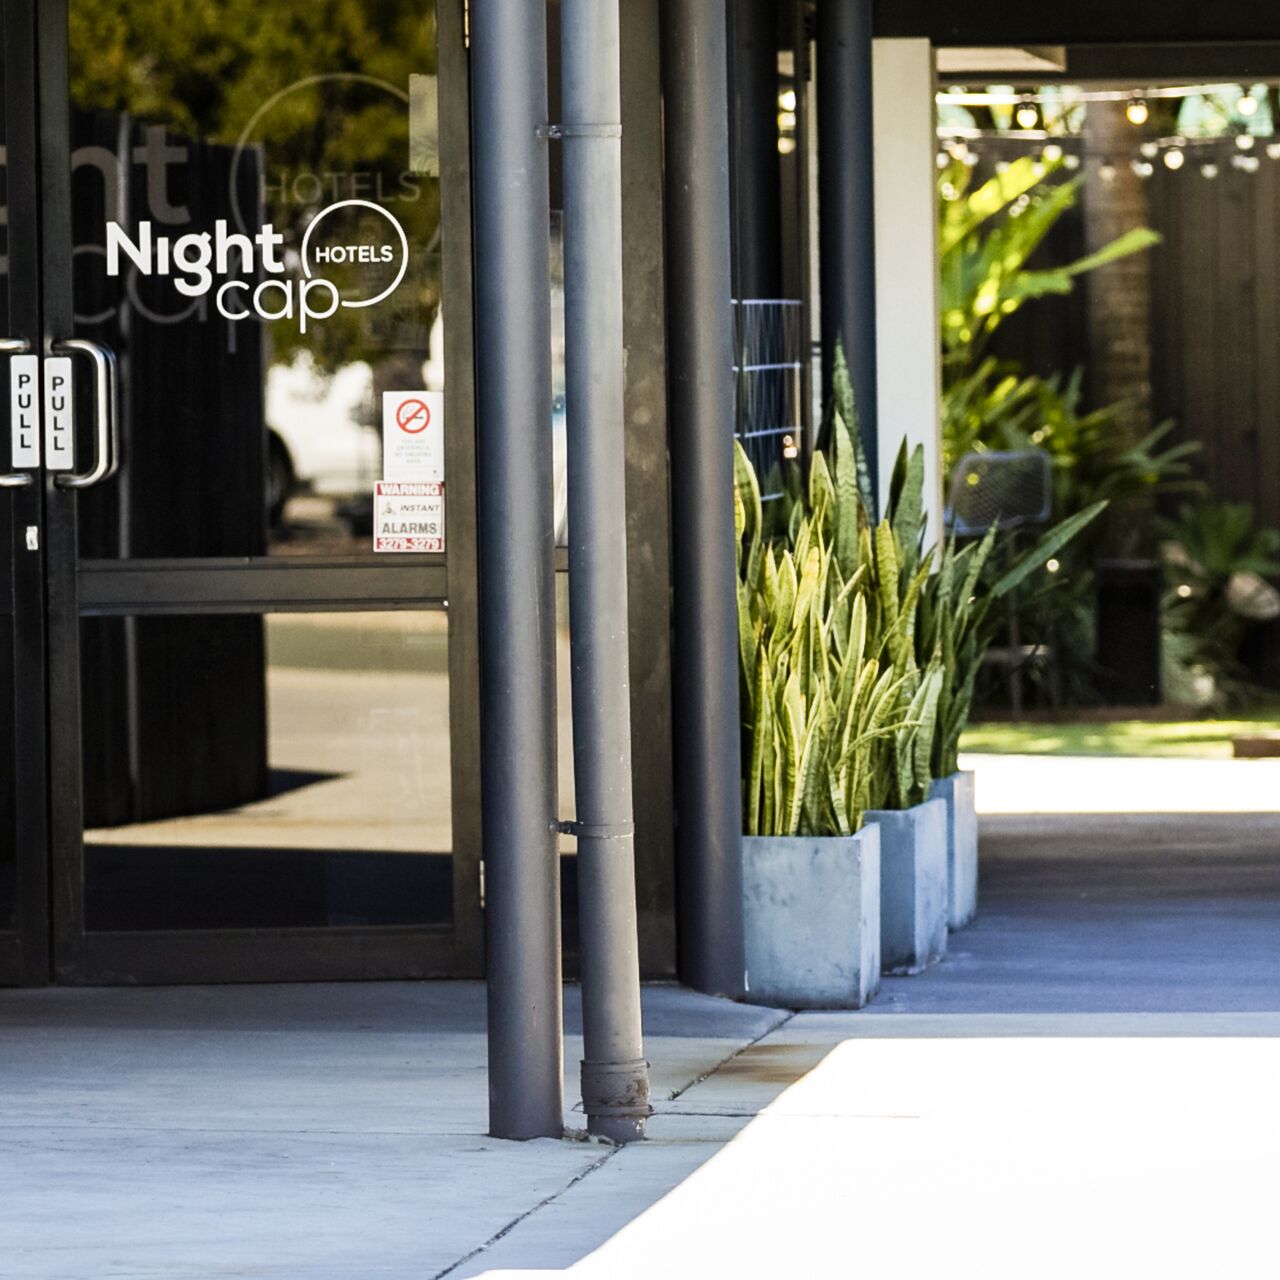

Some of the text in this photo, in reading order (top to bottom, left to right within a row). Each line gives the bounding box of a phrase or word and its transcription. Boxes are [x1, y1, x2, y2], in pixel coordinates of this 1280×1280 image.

[262, 170, 422, 205] HOTELS
[106, 219, 285, 296] Night
[315, 245, 394, 264] HOTELS
[215, 278, 340, 335] cap
[17, 373, 32, 450] PULL
[51, 376, 66, 452] PULL
[380, 483, 440, 496] WARNING
[400, 504, 440, 512] INSTANT
[382, 522, 437, 534] ALARMS
